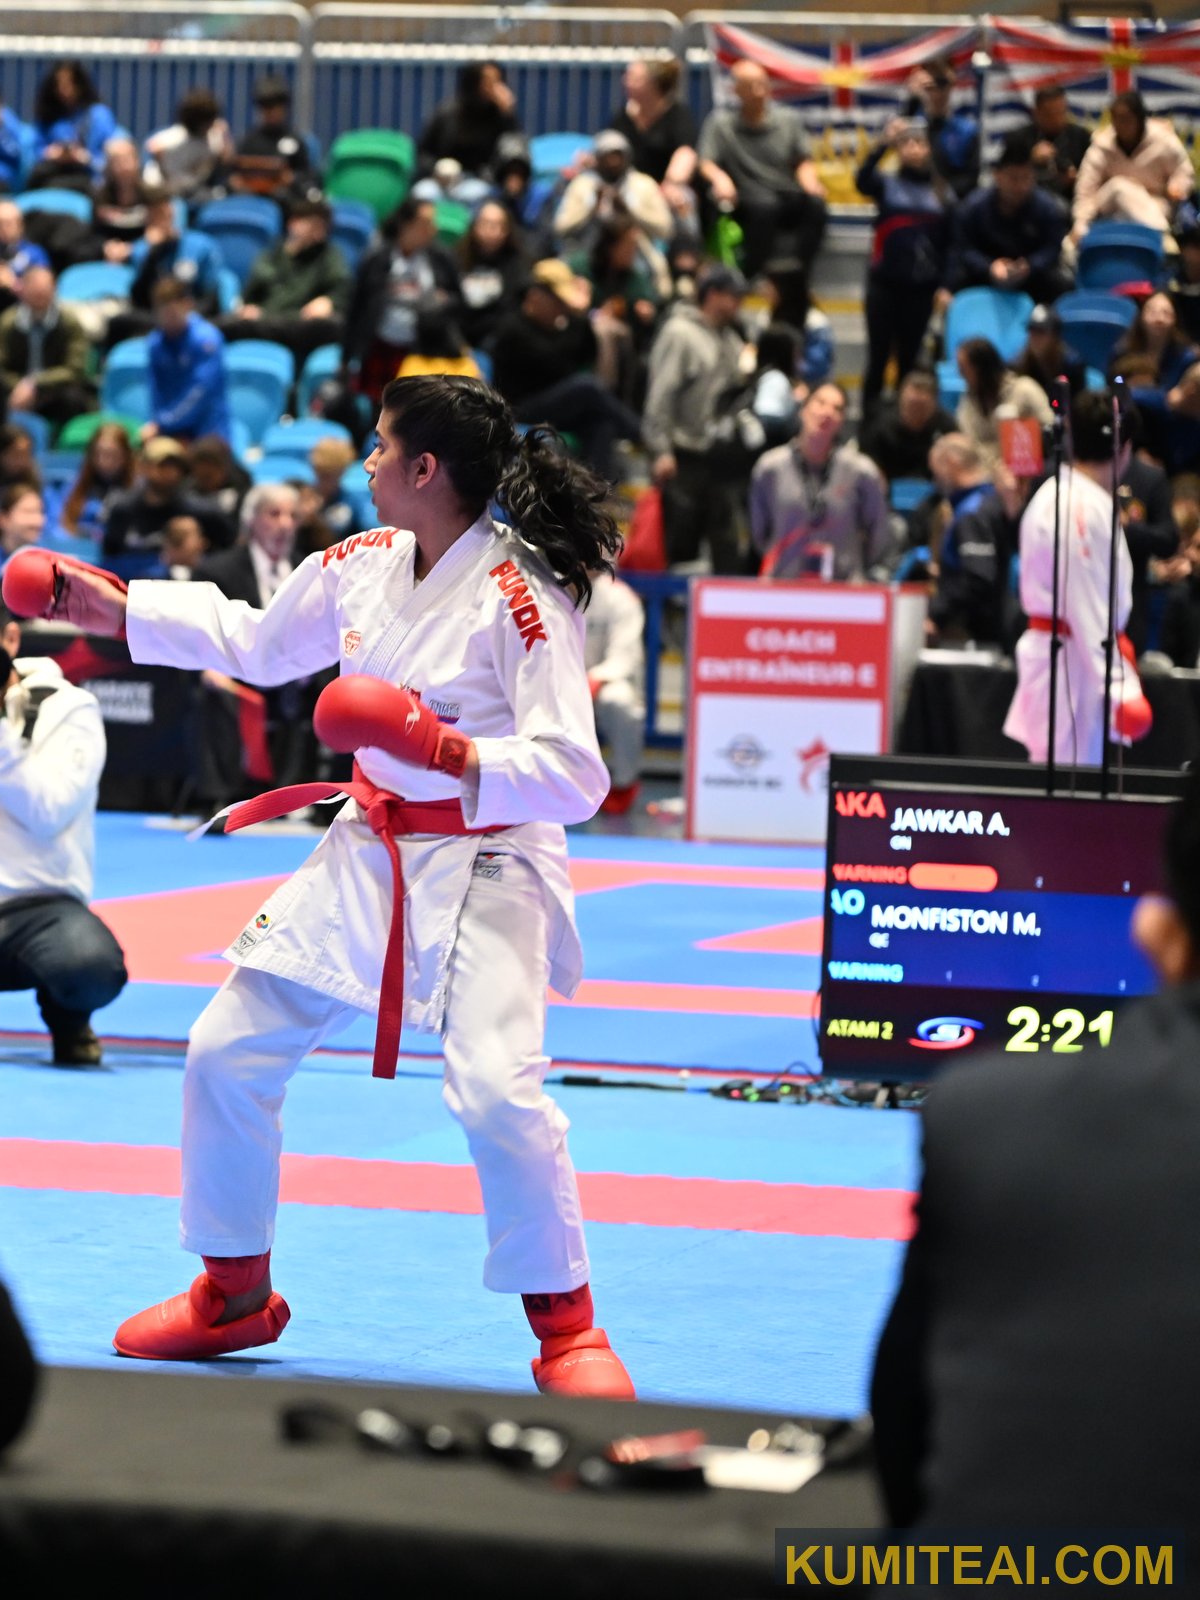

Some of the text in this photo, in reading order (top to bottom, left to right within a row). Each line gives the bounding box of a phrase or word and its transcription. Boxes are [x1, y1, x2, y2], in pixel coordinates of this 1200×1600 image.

[489, 560, 548, 653] PUNOK
[745, 627, 837, 654] COACH
[890, 807, 984, 835] JAWKAR
[871, 904, 1008, 934] MONFISTON
[1005, 1006, 1114, 1053] 2:21
